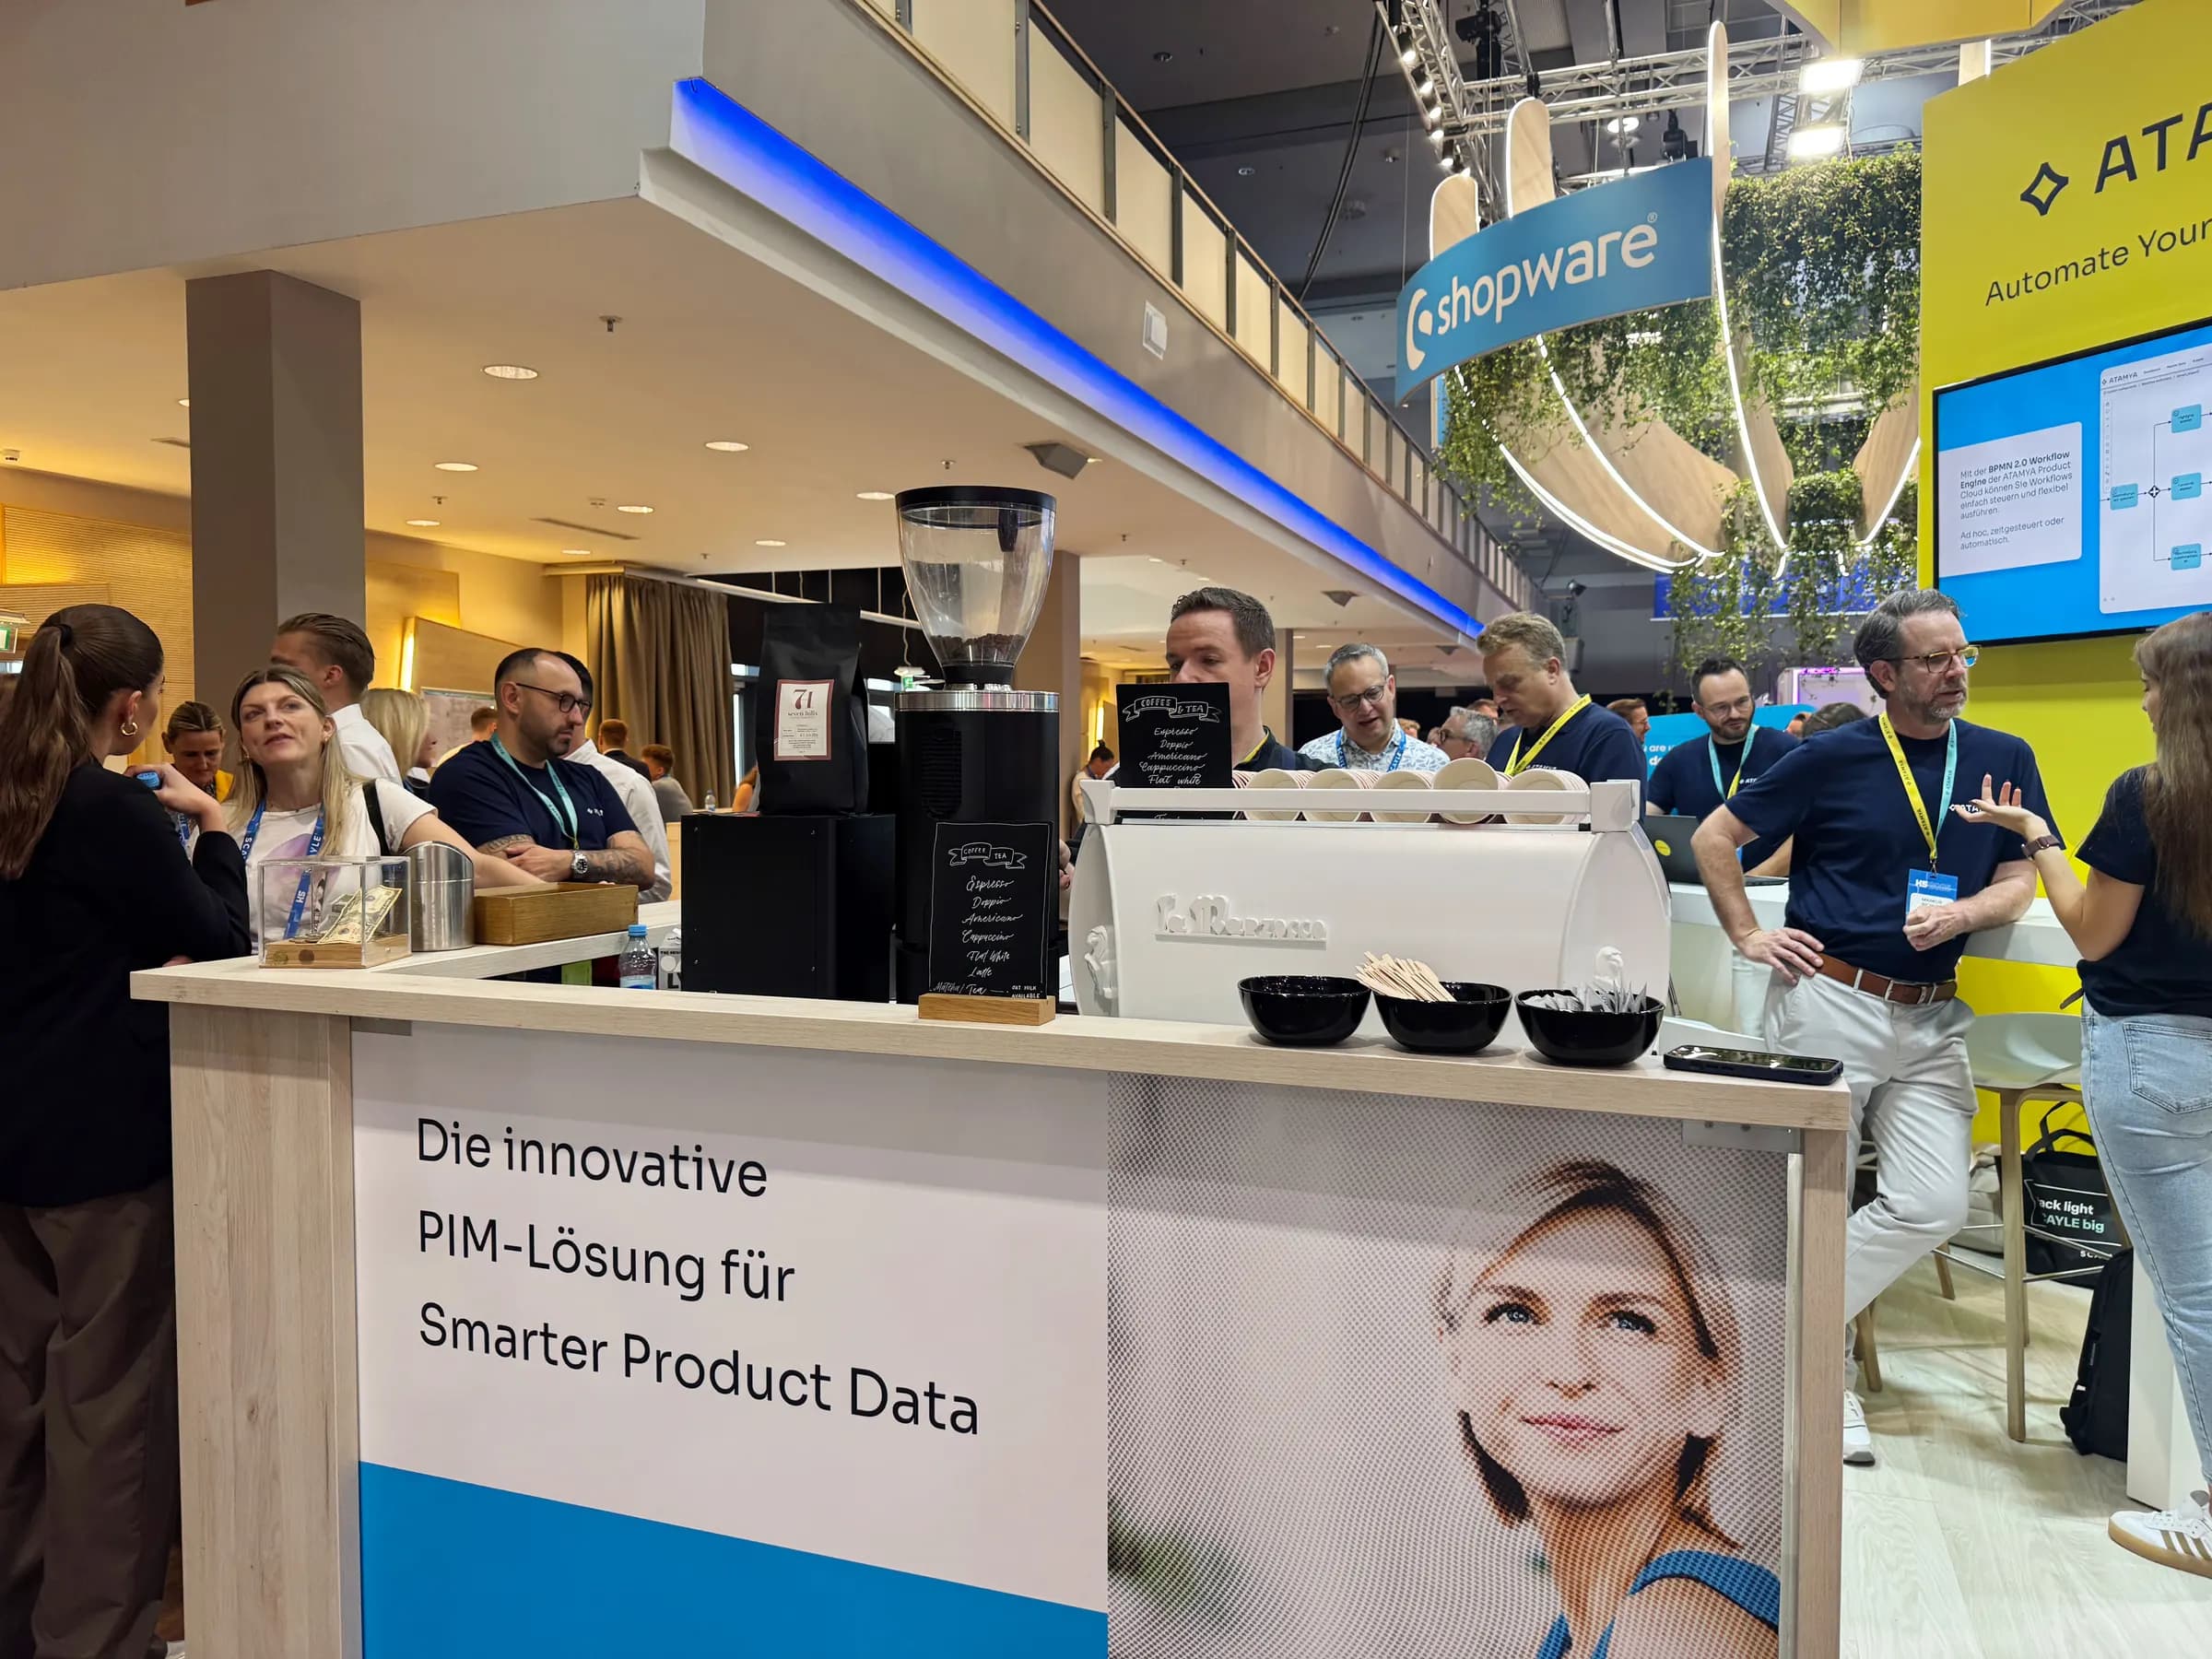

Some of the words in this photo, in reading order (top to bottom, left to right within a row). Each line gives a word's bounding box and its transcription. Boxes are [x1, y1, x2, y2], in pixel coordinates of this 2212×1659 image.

[1985, 245, 2129, 306] Automate
[2137, 218, 2212, 257] Your
[1960, 470, 1972, 479] Mit
[1974, 467, 1987, 477] der
[1988, 462, 2013, 474] BPMN
[2015, 458, 2028, 468] 2.0
[2029, 451, 2071, 465] Workflow
[1960, 478, 1987, 490] Engine
[1988, 476, 2002, 484] der
[2003, 468, 2036, 480] ATAMYA
[2038, 461, 2072, 474] Product
[1960, 487, 1983, 499] Cloud
[1984, 482, 2014, 495] können
[2015, 479, 2028, 488] Sie
[2030, 472, 2073, 486] Workflows
[1960, 498, 1988, 510] einfach
[1990, 493, 2019, 504] steuern
[2021, 488, 2037, 499] und
[2038, 482, 2069, 496] flexibel
[1960, 531, 1971, 539] Ad
[1972, 528, 1989, 538] hoc,
[1990, 519, 2043, 535] zeitgesteuert
[2044, 516, 2065, 526] oder
[1960, 536, 2010, 550] automatisch.
[1154, 726, 1198, 737] Espresso
[1159, 739, 1194, 750] Doppio
[1147, 751, 1207, 760] Americano
[1139, 761, 1206, 774] Cappuccino
[1147, 774, 1173, 784] Flat
[963, 847, 986, 855] COFFEE
[966, 876, 1014, 891] Espresso
[971, 896, 1012, 910] Doppio
[961, 912, 1023, 925] Americano
[962, 929, 1015, 944] Cappuccino
[967, 948, 988, 962] Flat
[990, 949, 1010, 962] White
[967, 966, 994, 978] Latte
[966, 983, 988, 995] Tea
[418, 1116, 491, 1168] Die
[504, 1125, 768, 1197] innovative
[2036, 1198, 2062, 1210] ack
[2064, 1200, 2094, 1216] light
[2082, 1218, 2105, 1233] big
[419, 1209, 705, 1302] PIM-Lösung
[721, 1249, 794, 1301] für
[419, 1301, 608, 1373] Smarter
[623, 1333, 832, 1413] Product
[850, 1367, 980, 1436] Data
